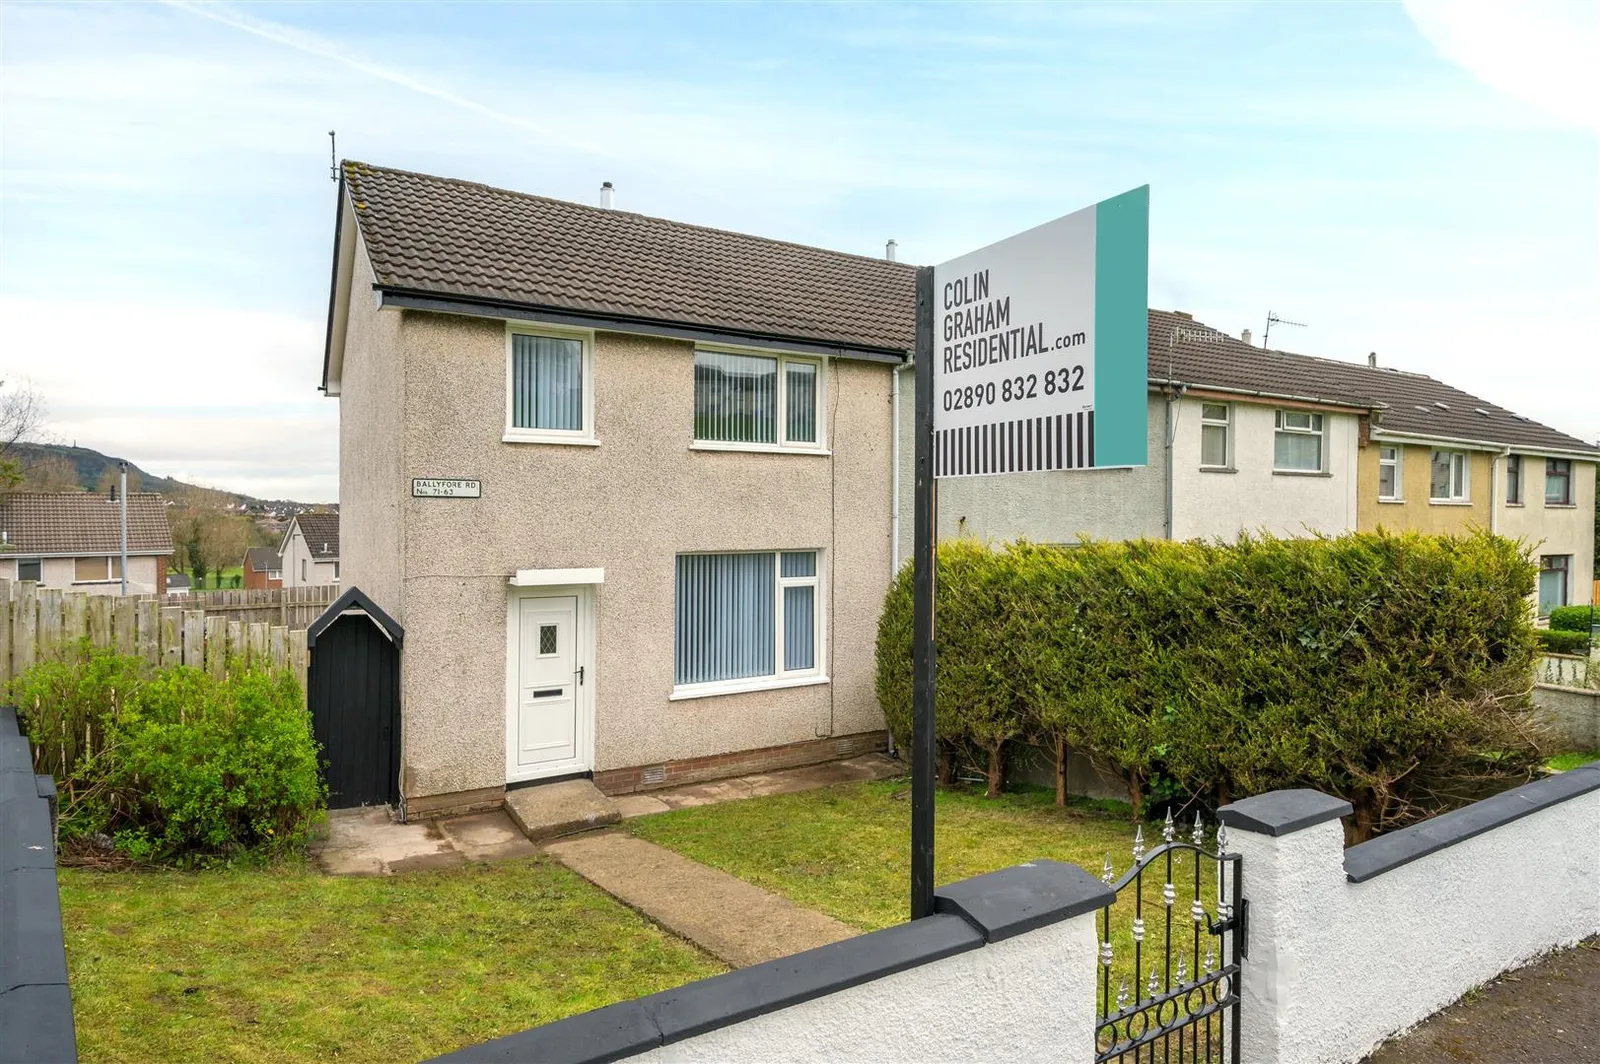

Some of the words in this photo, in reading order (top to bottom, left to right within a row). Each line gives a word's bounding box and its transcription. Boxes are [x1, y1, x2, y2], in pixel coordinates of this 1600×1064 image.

[944, 269, 989, 310] COLIN
[944, 296, 1010, 342] GRAHAM
[943, 322, 1086, 374] RESIDENTIAL.com
[943, 381, 995, 412] 02890
[1002, 373, 1037, 402] 832
[1044, 364, 1085, 396] 832
